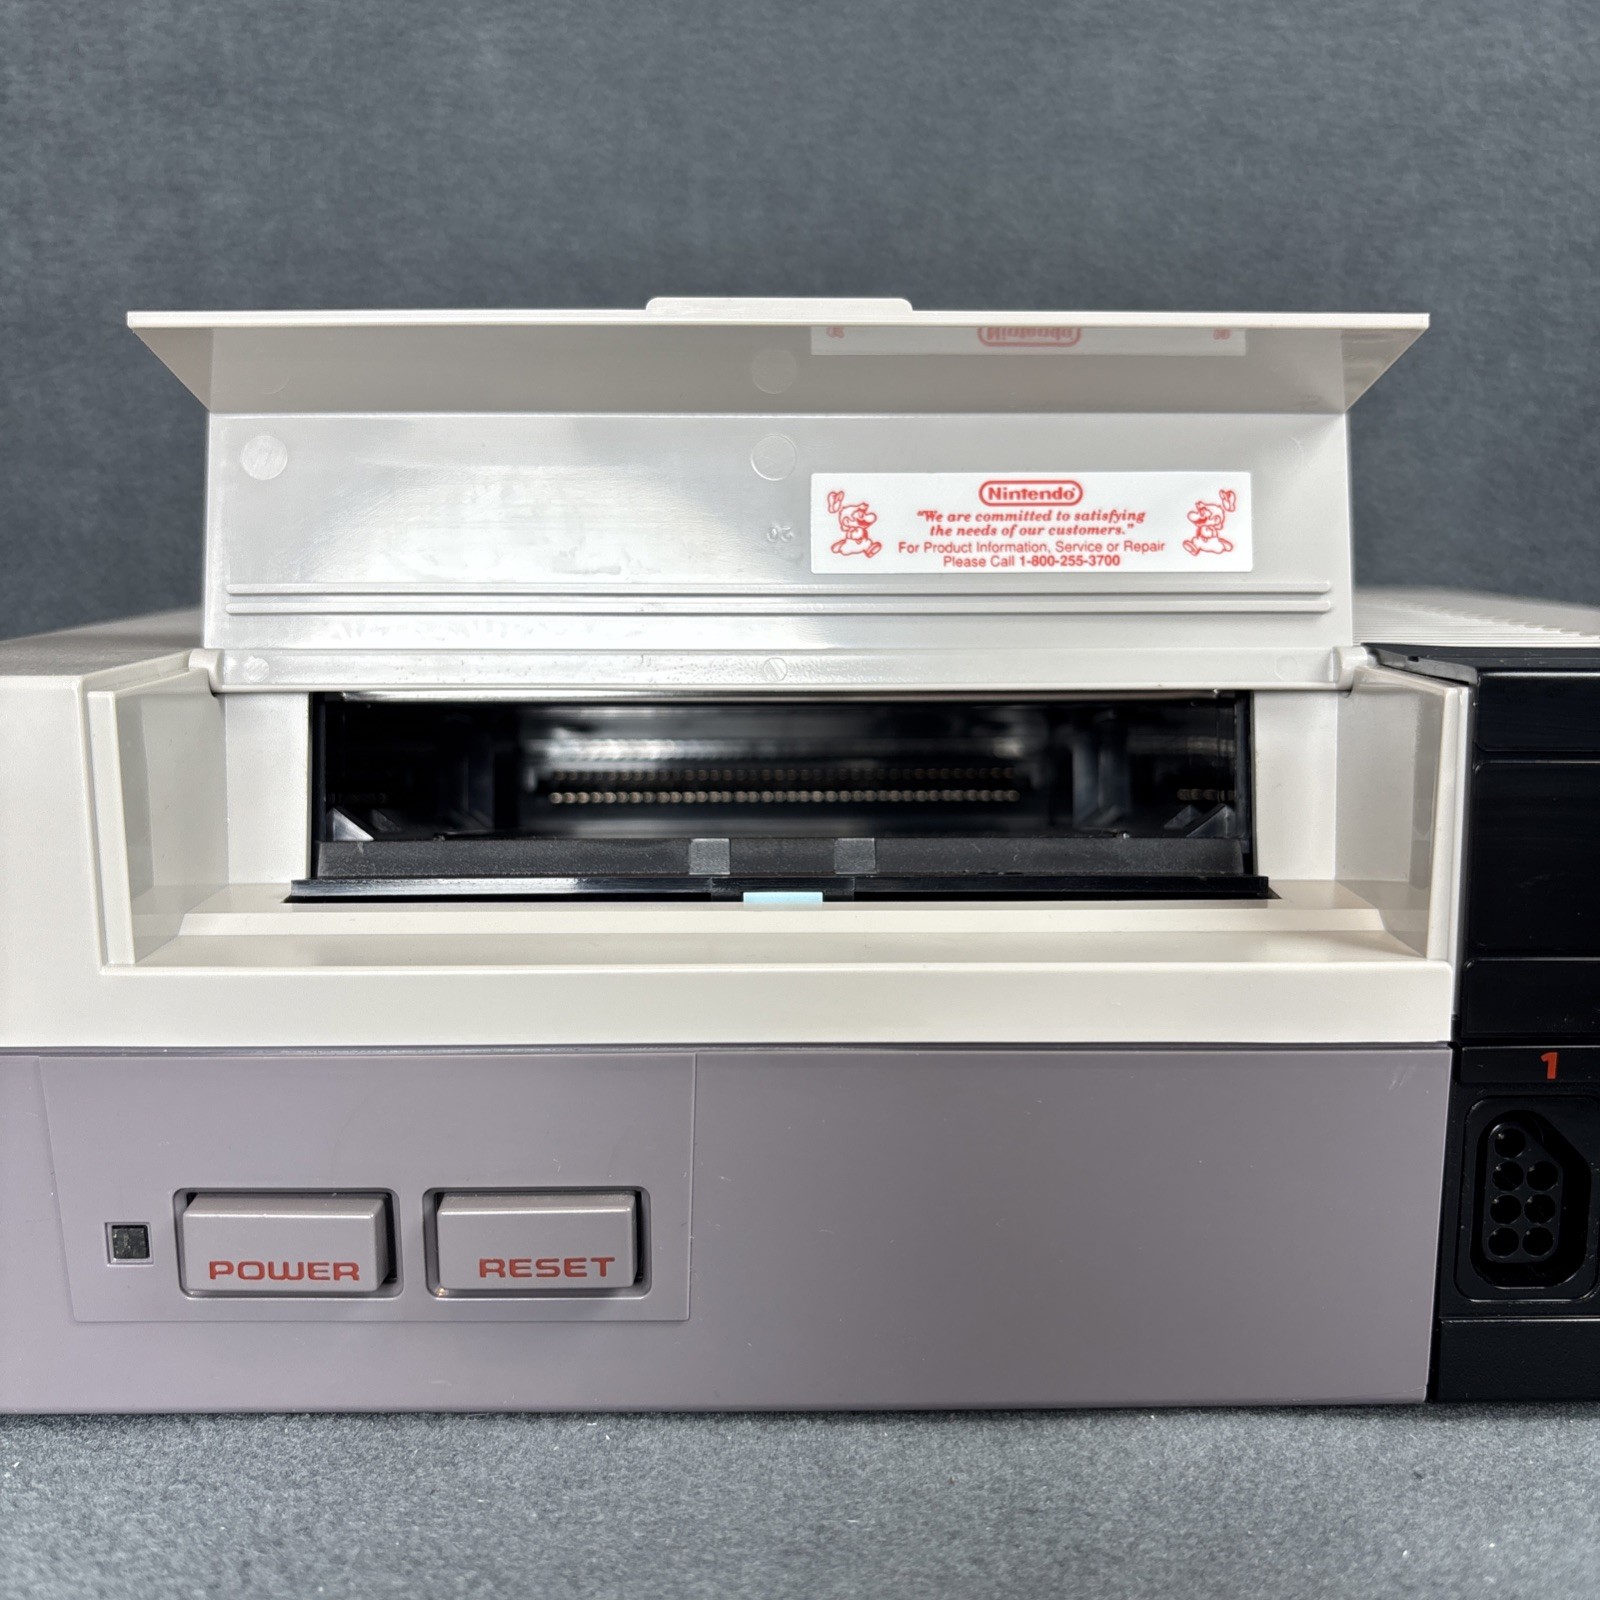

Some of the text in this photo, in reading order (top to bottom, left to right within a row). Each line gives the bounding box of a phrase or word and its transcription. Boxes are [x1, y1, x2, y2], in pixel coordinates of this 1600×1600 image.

[988, 487, 1075, 500] Nintendo
[947, 513, 971, 522] are
[975, 510, 1052, 522] committed
[1056, 511, 1071, 521] to
[1074, 509, 1146, 524] satisfying
[930, 525, 953, 536] the
[956, 524, 997, 536] needs
[1001, 524, 1017, 538] of
[1019, 527, 1045, 536] our
[898, 540, 1165, 554] For Product Information, Service or Repair
[943, 554, 1121, 567] Please Call 1-800-255-3700
[1540, 1051, 1559, 1080] 1
[209, 1261, 360, 1281] POWER
[479, 1257, 615, 1278] RESET
